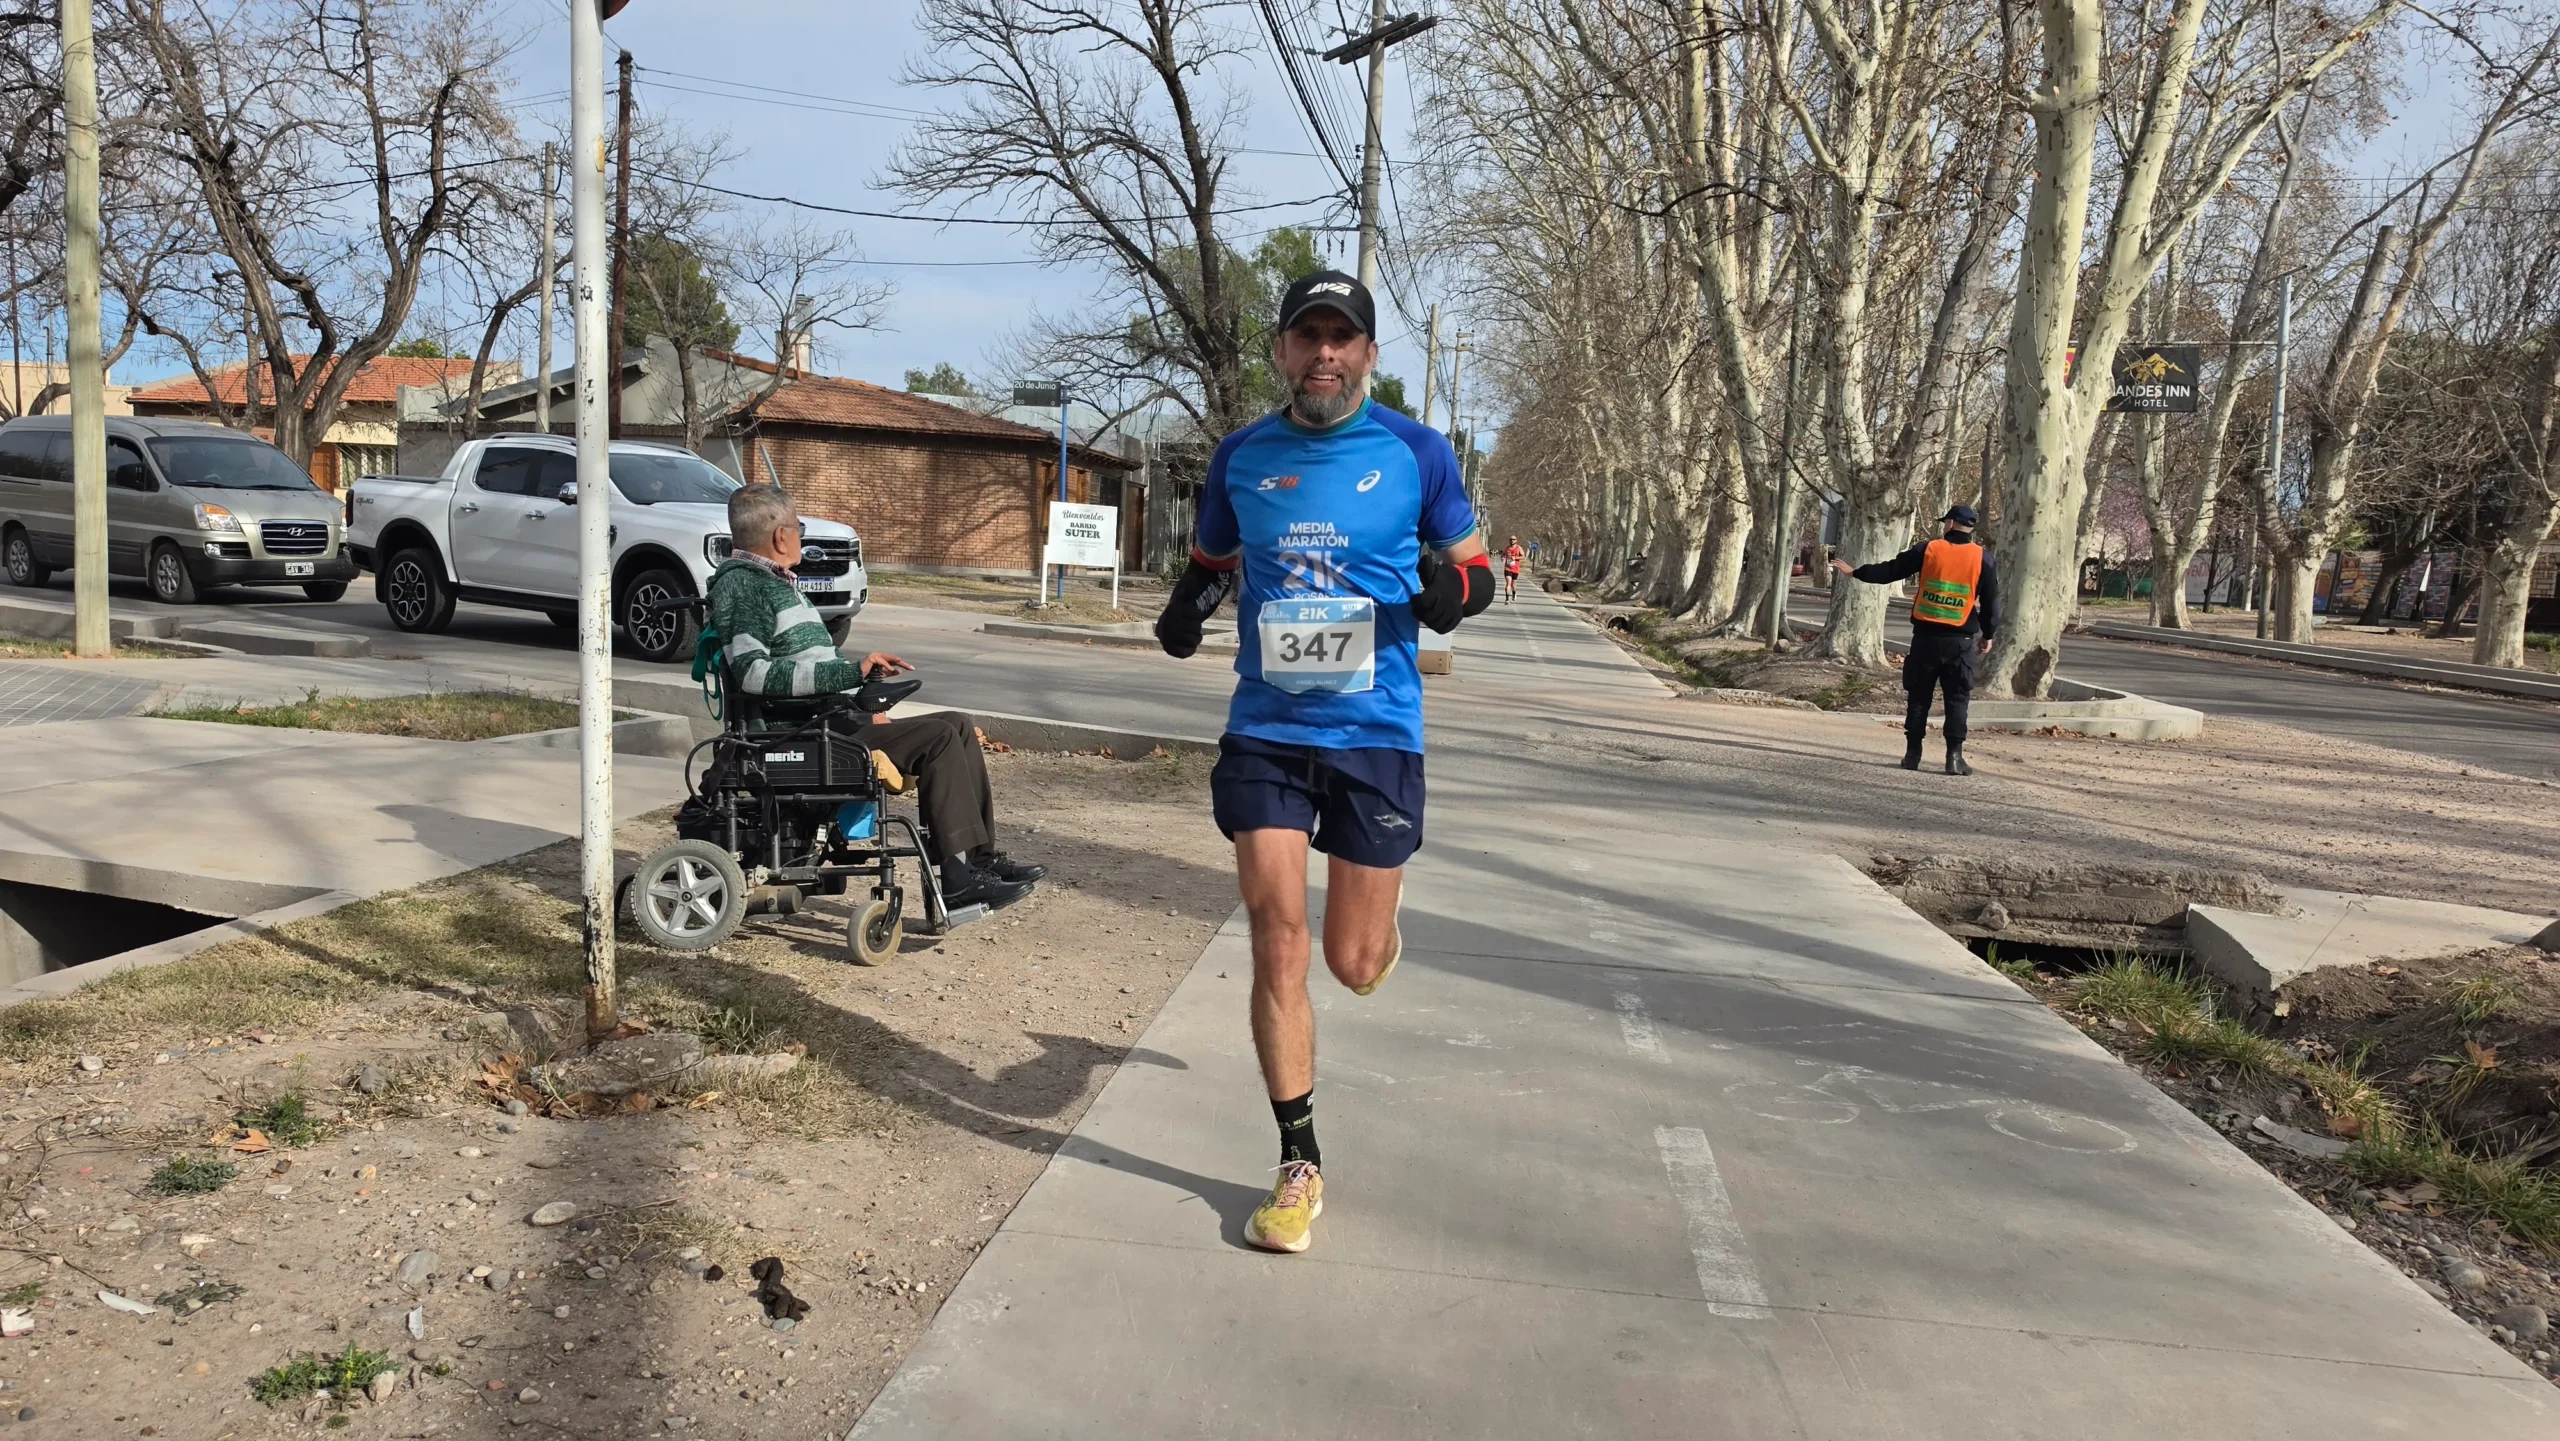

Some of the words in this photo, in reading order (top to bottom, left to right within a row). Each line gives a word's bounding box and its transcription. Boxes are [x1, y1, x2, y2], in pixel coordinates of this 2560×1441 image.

[1014, 381, 1024, 389] 20
[1025, 381, 1035, 389] de
[1035, 382, 1056, 390] Junio
[2116, 385, 2162, 397] ANDES
[2165, 385, 2190, 397] INN
[2134, 399, 2168, 407] HOTEL
[1062, 509, 1105, 521] Bienvenidos
[1070, 522, 1097, 530] BARRIO
[1289, 522, 1336, 534] MEDIA
[1065, 529, 1101, 539] SUTER
[810, 582, 822, 591] 411
[824, 582, 833, 591] VS
[1922, 590, 1964, 608] POLICIA
[1299, 606, 1330, 620] 21K
[1279, 632, 1353, 663] 347
